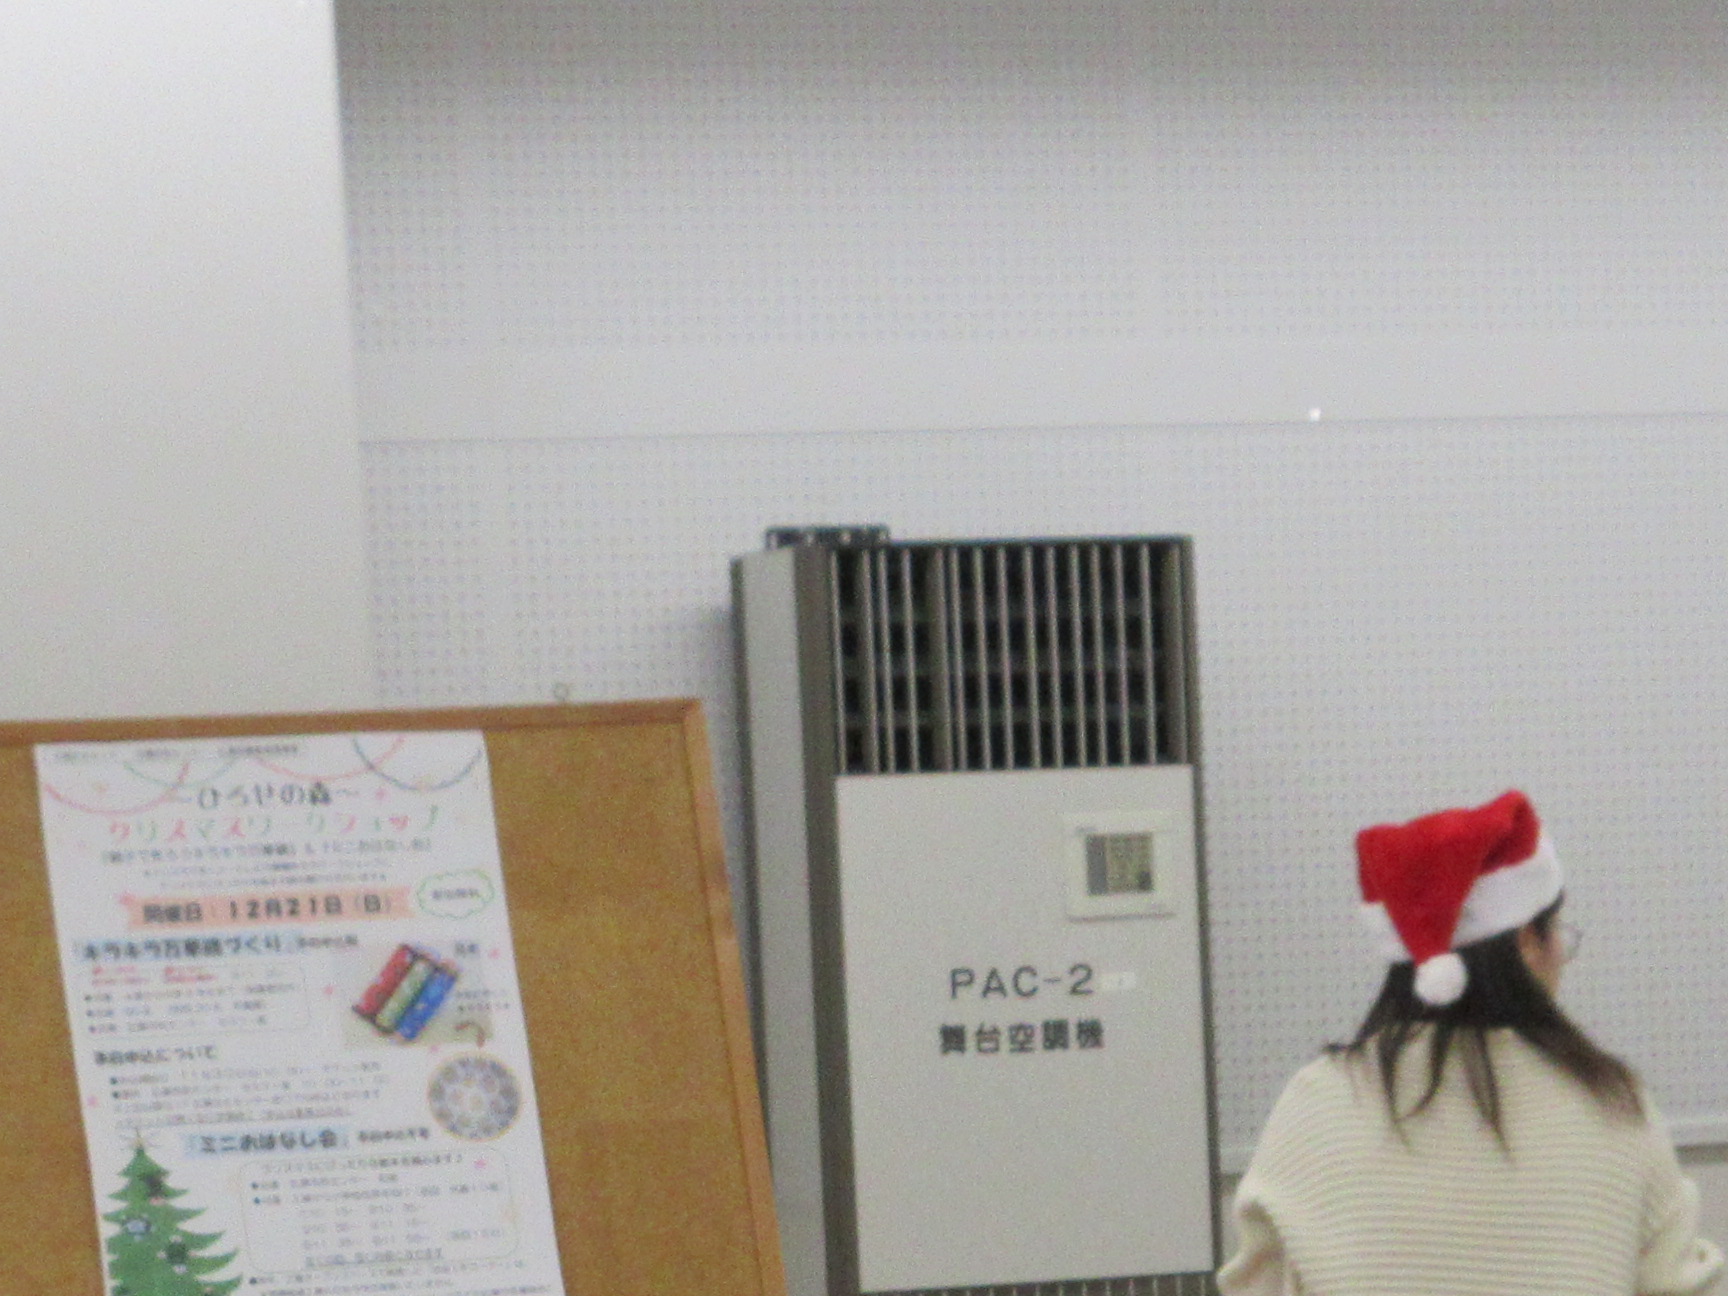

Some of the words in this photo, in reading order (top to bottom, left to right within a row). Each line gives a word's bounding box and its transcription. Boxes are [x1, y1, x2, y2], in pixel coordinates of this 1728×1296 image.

[950, 963, 1096, 1000] PAC-2
[939, 1018, 1105, 1055] 舞台空調機
